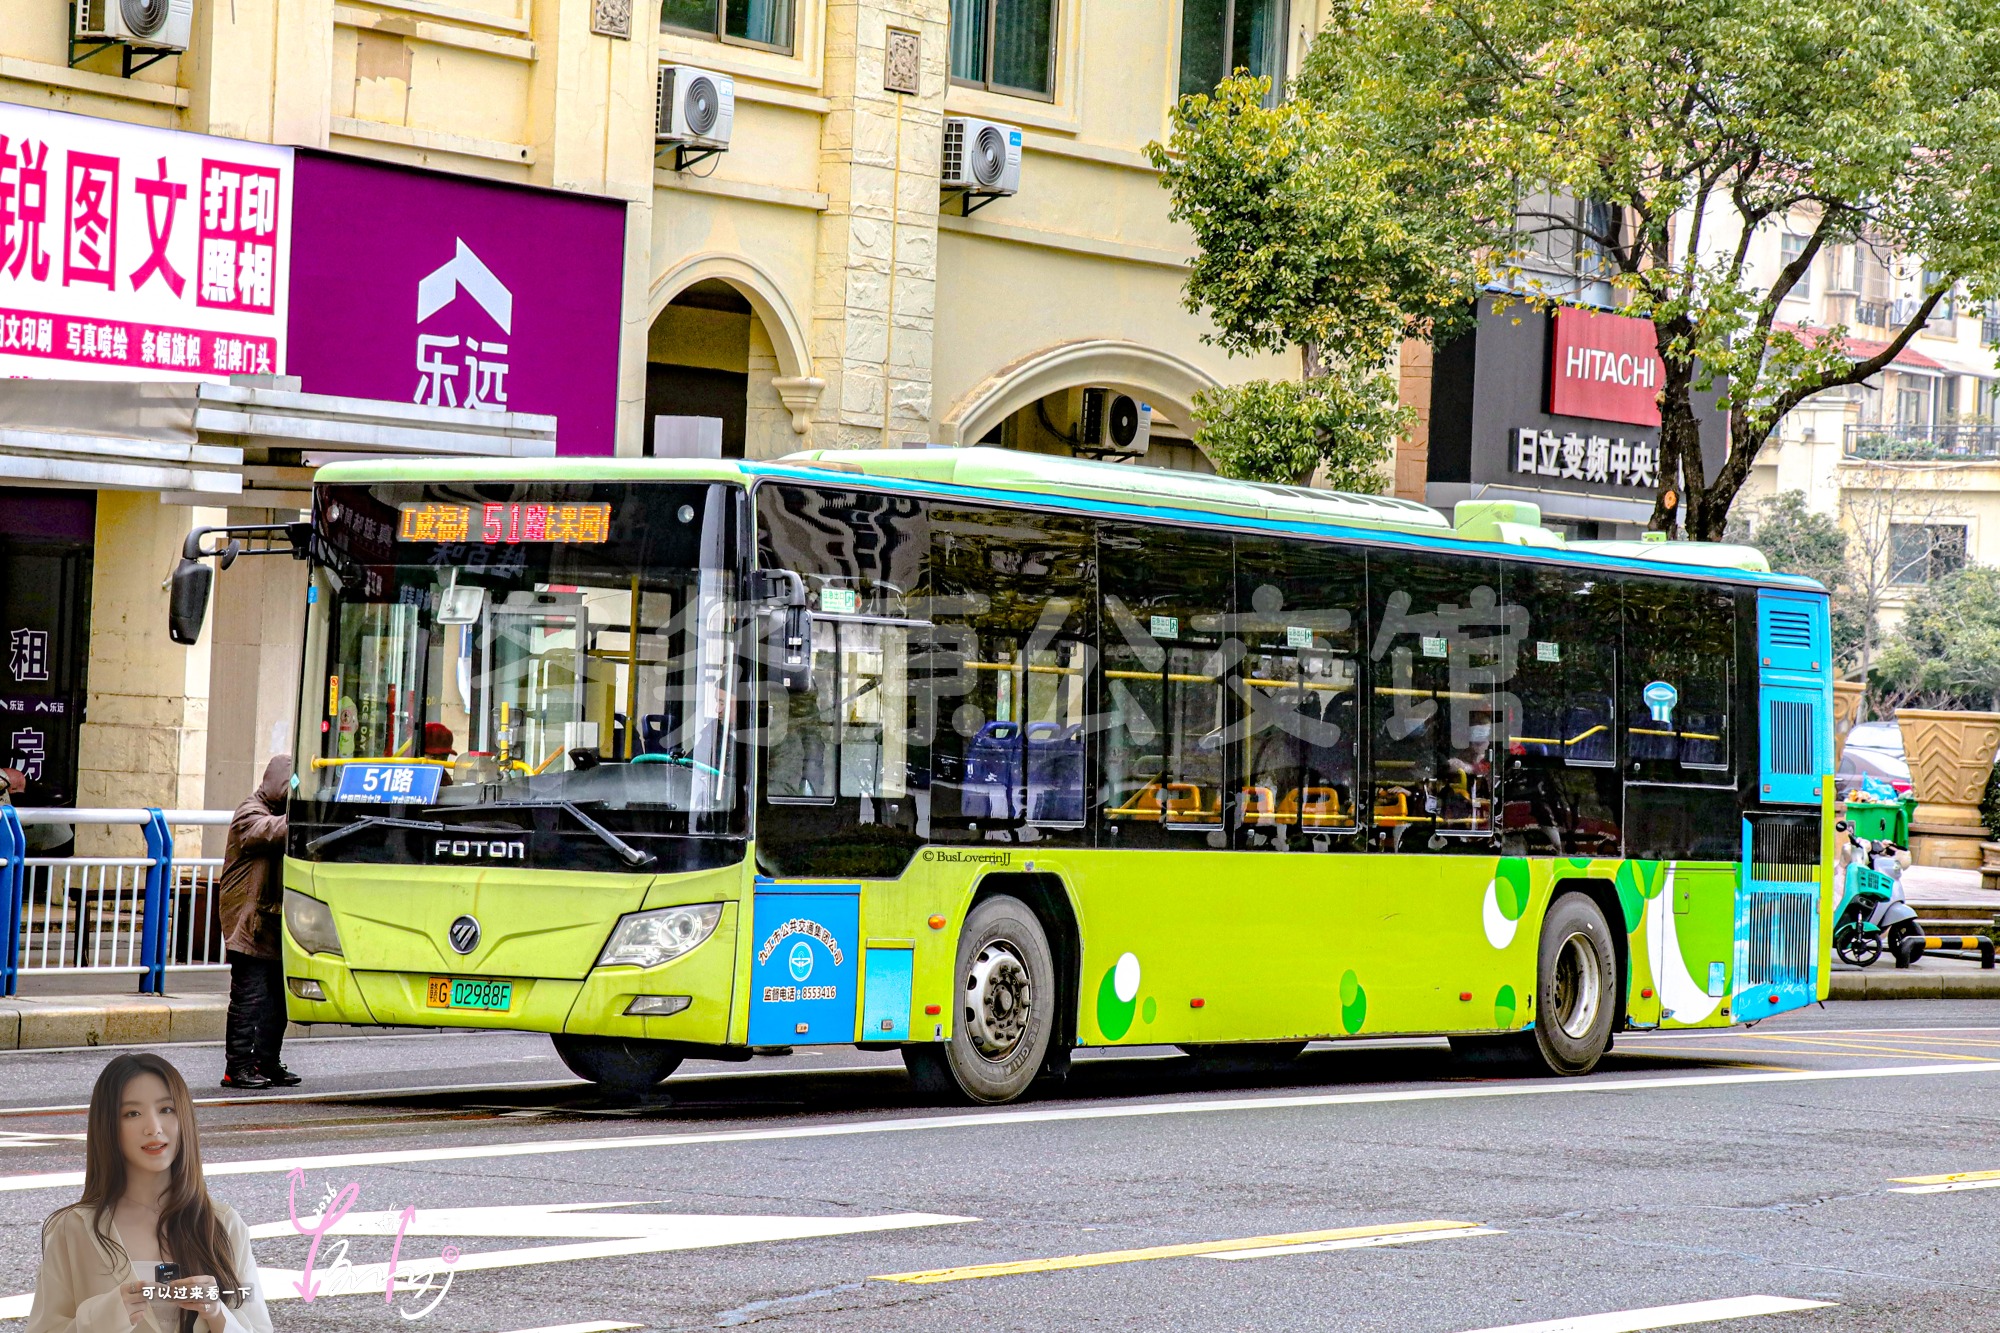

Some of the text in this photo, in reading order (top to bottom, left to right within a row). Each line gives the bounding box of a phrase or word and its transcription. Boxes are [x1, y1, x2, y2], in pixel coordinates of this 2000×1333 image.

[204, 167, 276, 236] 打印
[201, 238, 274, 307] 照相
[66, 322, 129, 361] 写真喷绘
[141, 329, 201, 368] 条幅旗帜
[213, 337, 272, 374] 招牌门头
[414, 334, 510, 412] 乐远
[1566, 346, 1656, 388] HITACHI
[1516, 427, 1660, 489] 日立变频中央
[362, 767, 414, 793] 51路
[435, 839, 525, 859] FOTON
[758, 918, 844, 967] 九江市公共交通集团公司
